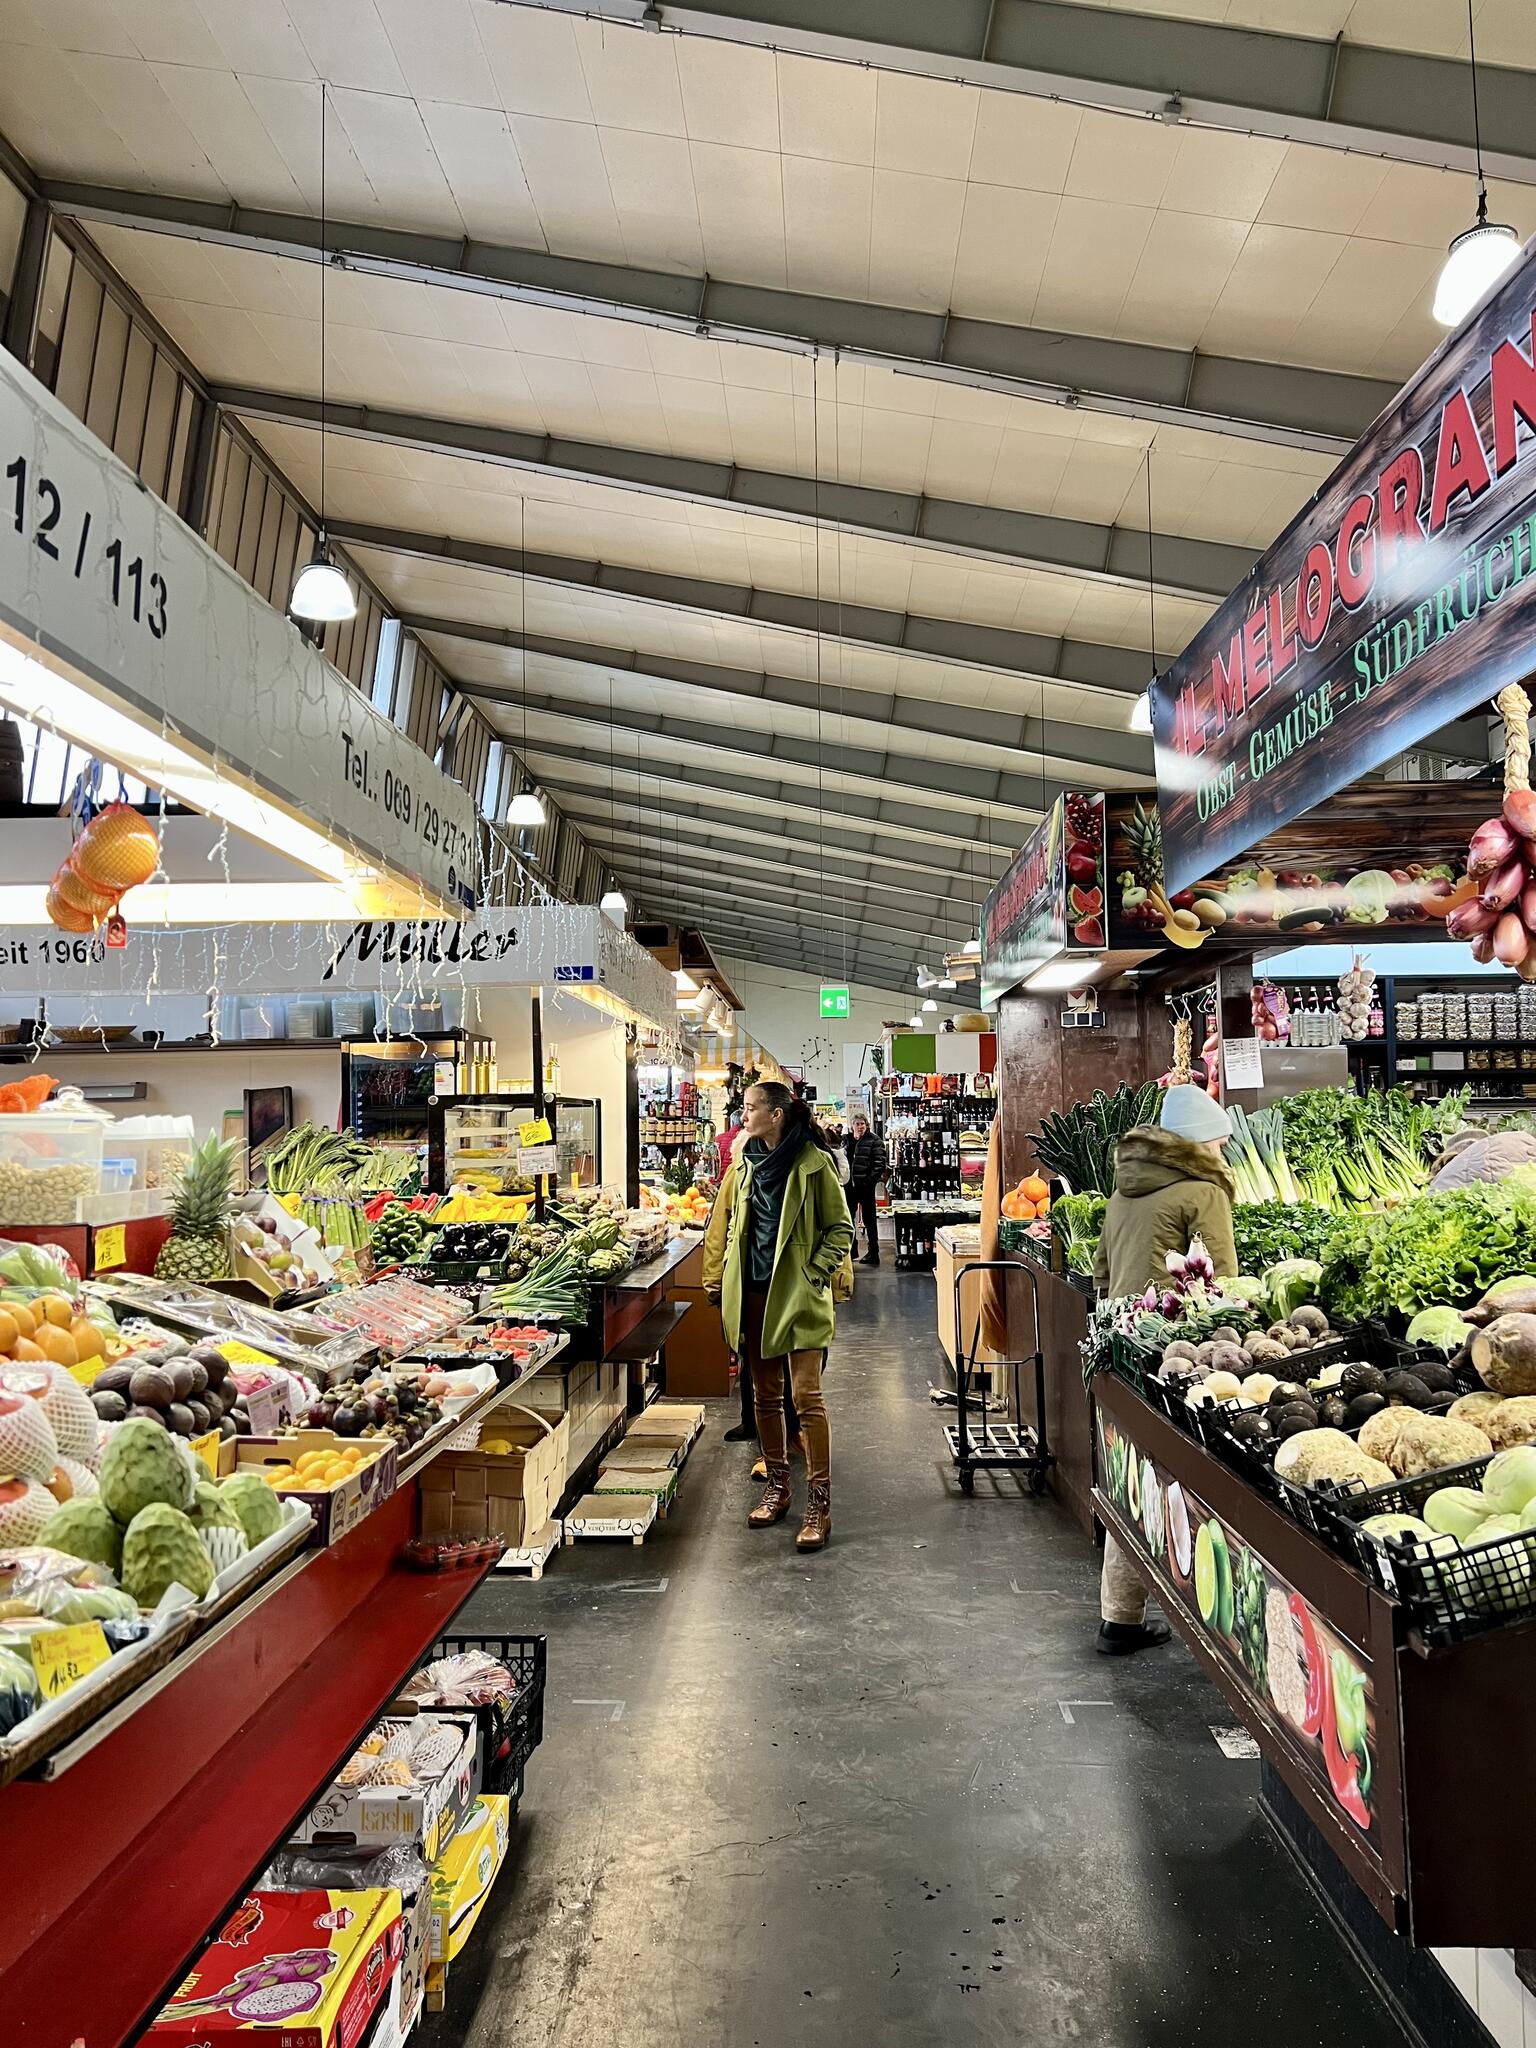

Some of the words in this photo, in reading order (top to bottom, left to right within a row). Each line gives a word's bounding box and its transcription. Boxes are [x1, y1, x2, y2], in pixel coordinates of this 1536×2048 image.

[6, 455, 61, 561] 12
[74, 511, 91, 579] /
[106, 538, 167, 639] 113
[384, 768, 411, 825] 069
[423, 802, 439, 847] 29
[442, 819, 457, 855] 27
[459, 831, 473, 872] 31
[39, 940, 105, 965] 1960
[322, 921, 518, 981] Müller
[173, 1970, 203, 1998] FRUIT
